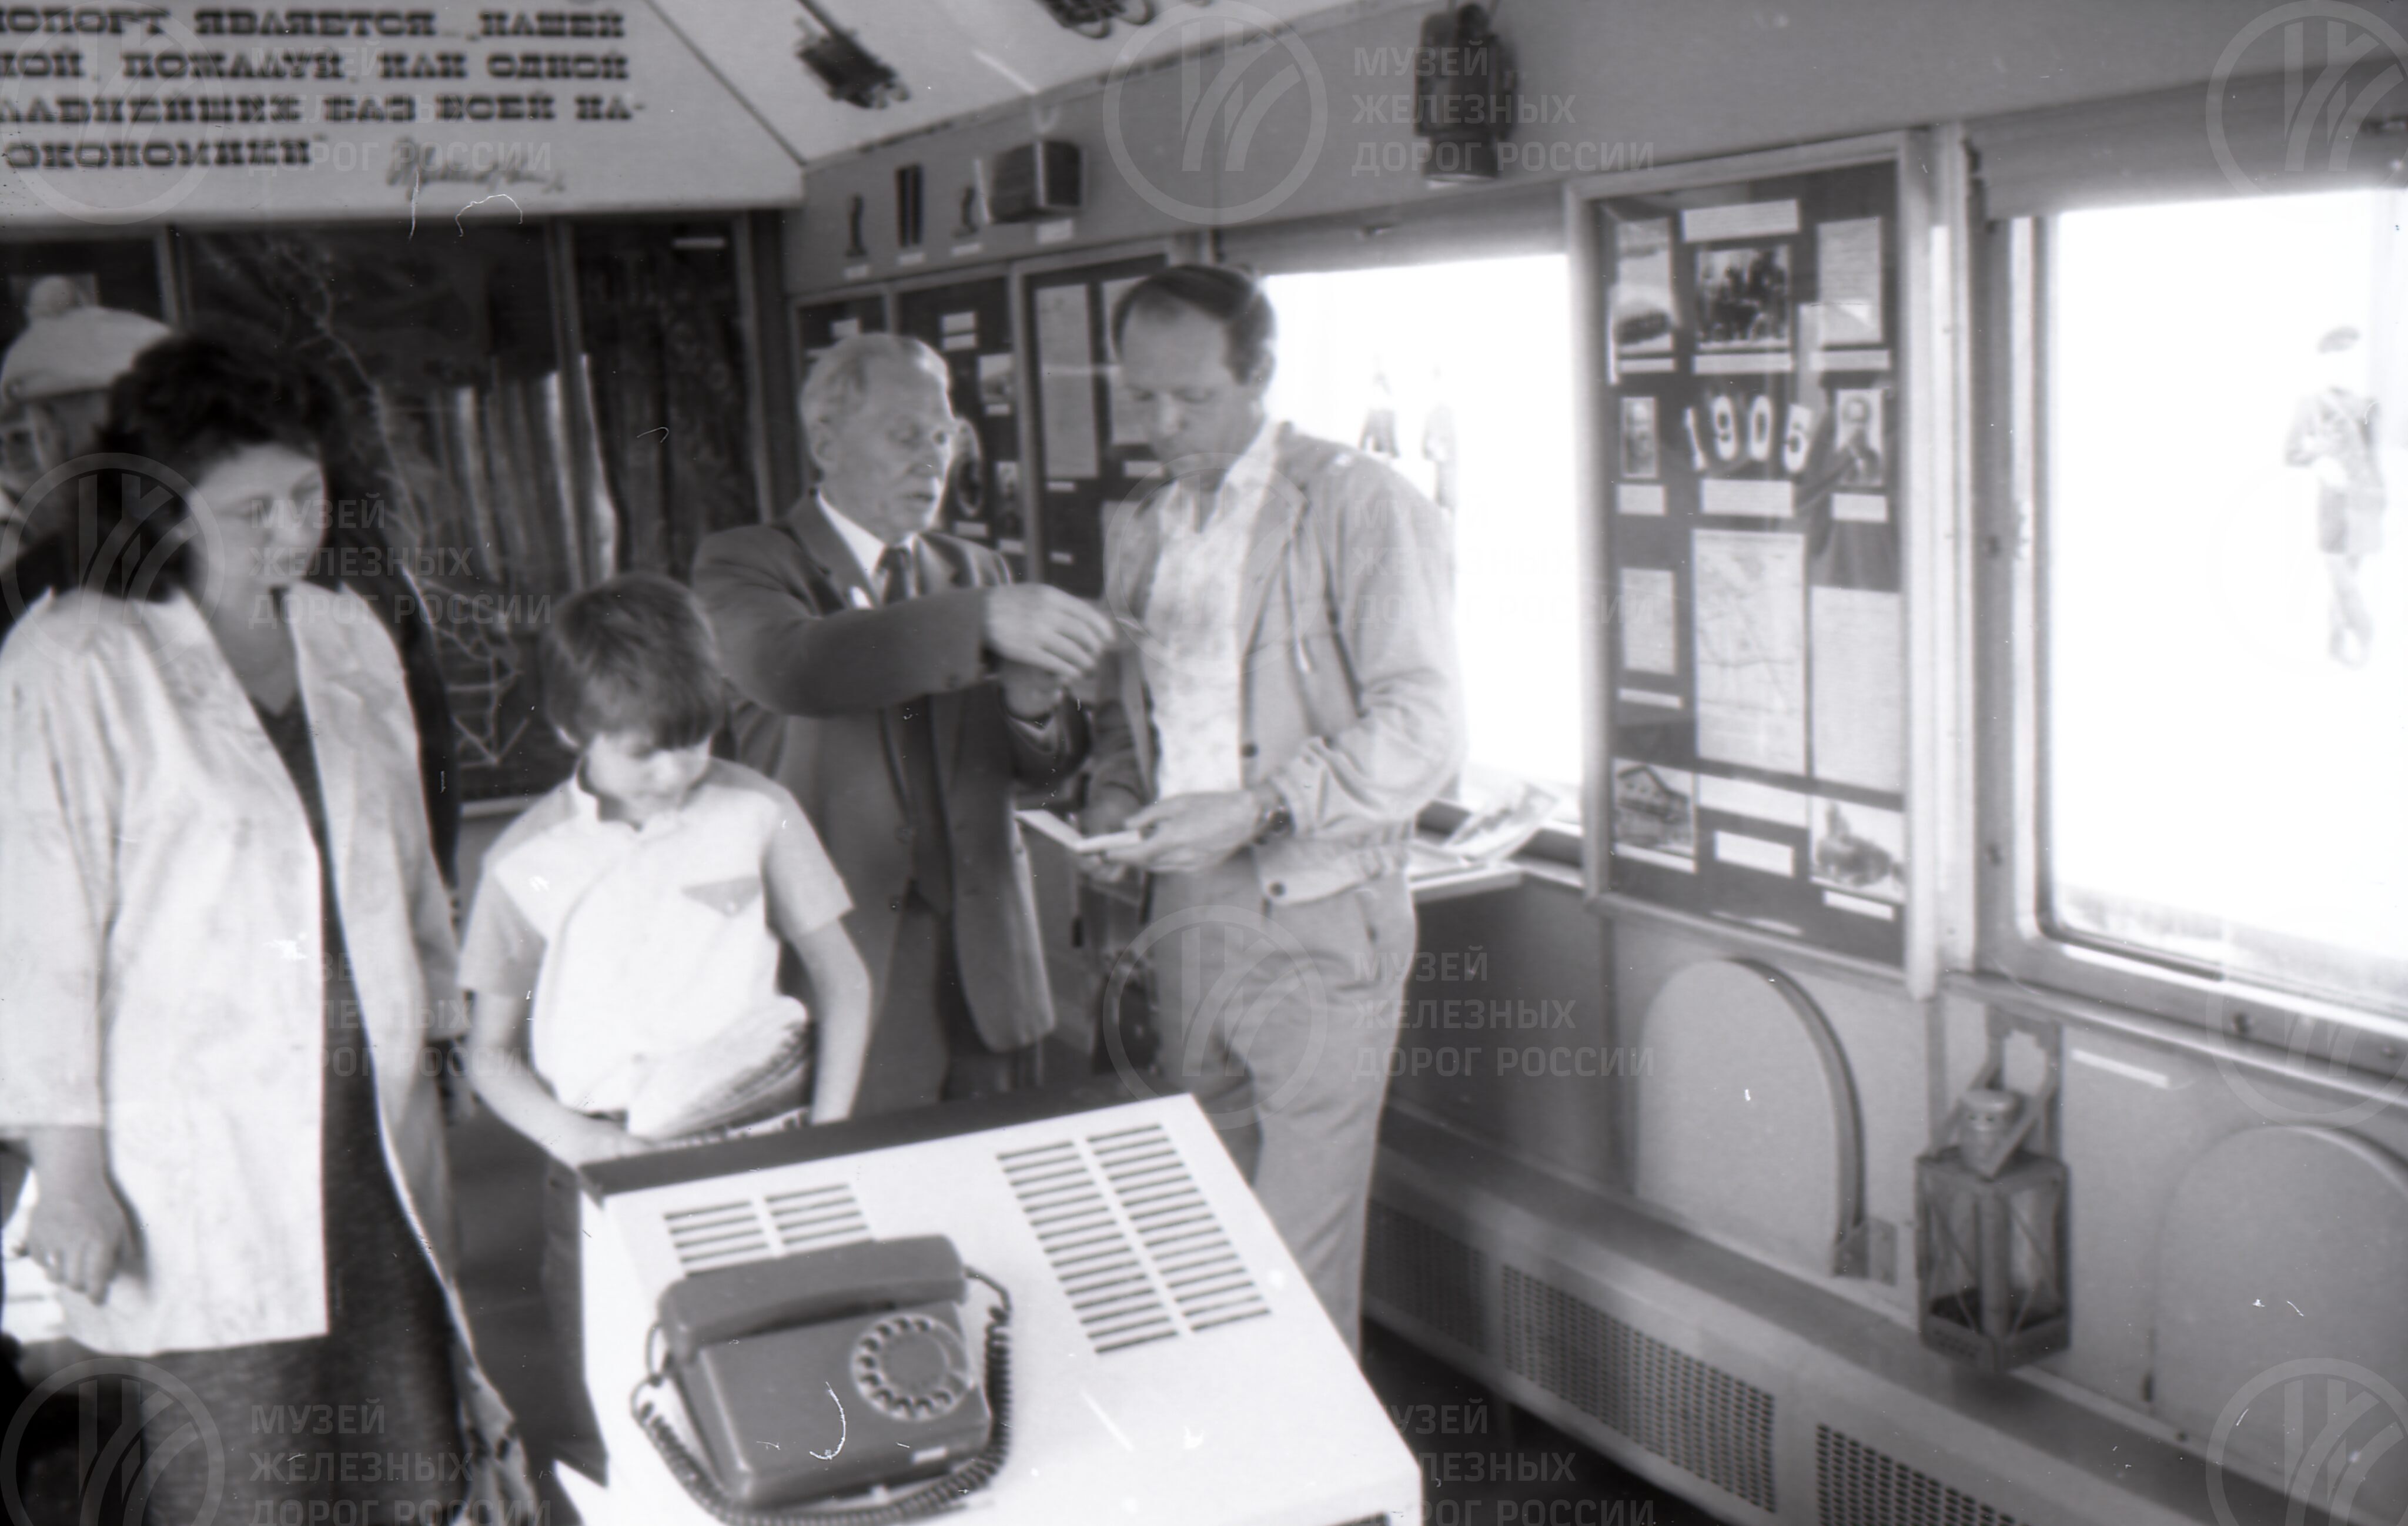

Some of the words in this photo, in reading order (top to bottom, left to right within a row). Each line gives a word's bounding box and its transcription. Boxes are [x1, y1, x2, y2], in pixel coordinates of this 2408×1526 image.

[0, 8, 170, 35] СПОРТ
[194, 9, 437, 36] ЯВЛЯЕТСЯ
[487, 48, 629, 80] ОДНОЙ
[436, 92, 556, 120] ВСЕЙ
[1684, 395, 1814, 473] 1905
